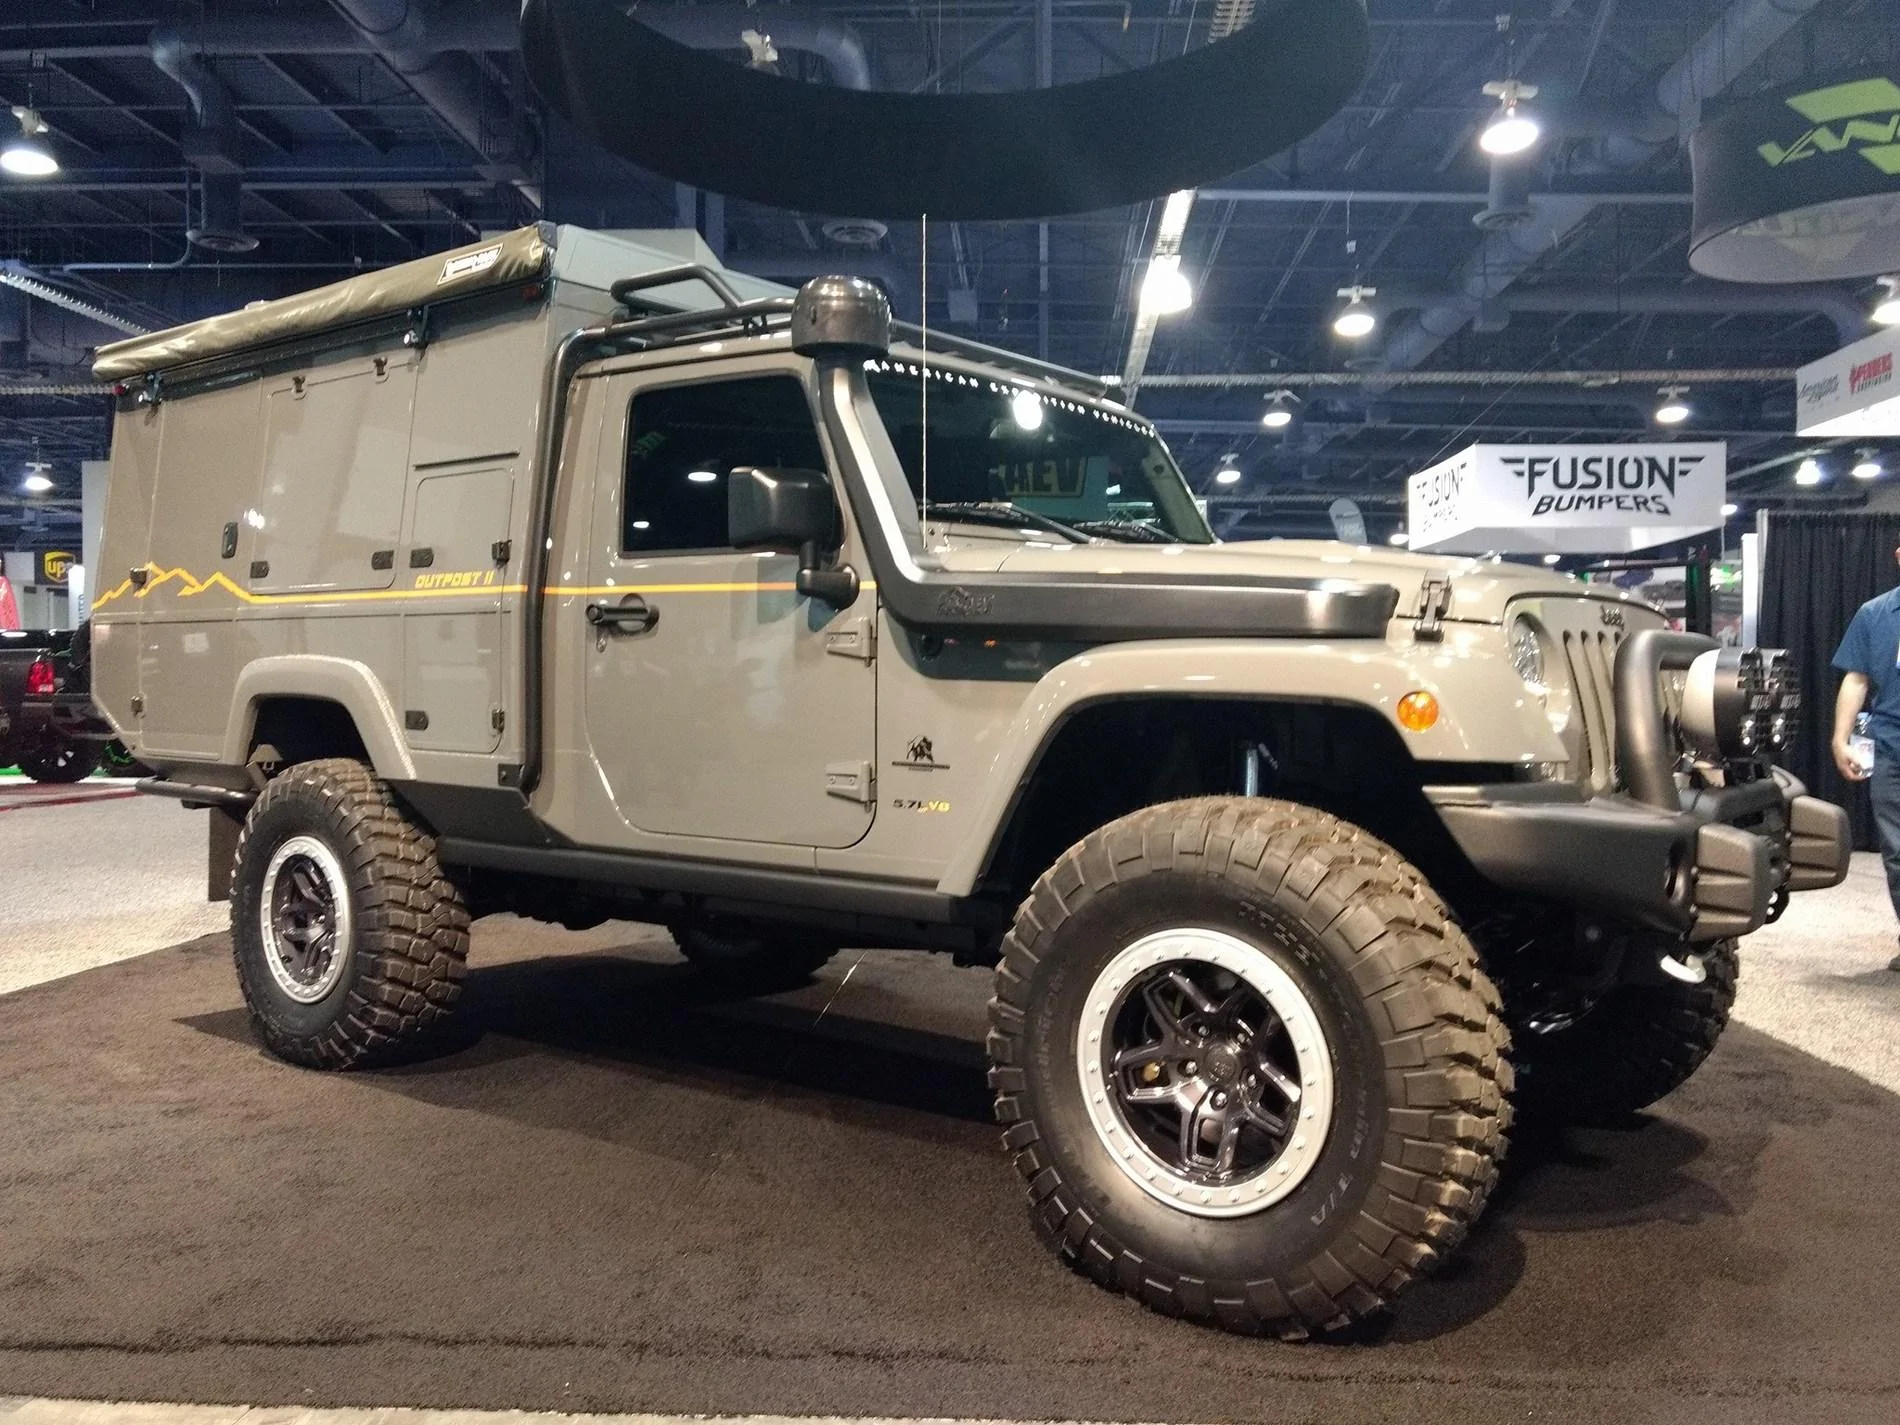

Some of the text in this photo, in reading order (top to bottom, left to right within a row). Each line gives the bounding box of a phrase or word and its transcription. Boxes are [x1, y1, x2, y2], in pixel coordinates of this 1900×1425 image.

[988, 382, 1085, 415] EXPITION
[1527, 456, 1677, 500] FUSION
[1532, 494, 1671, 517] BUMPERS
[415, 571, 482, 588] OUTPOST
